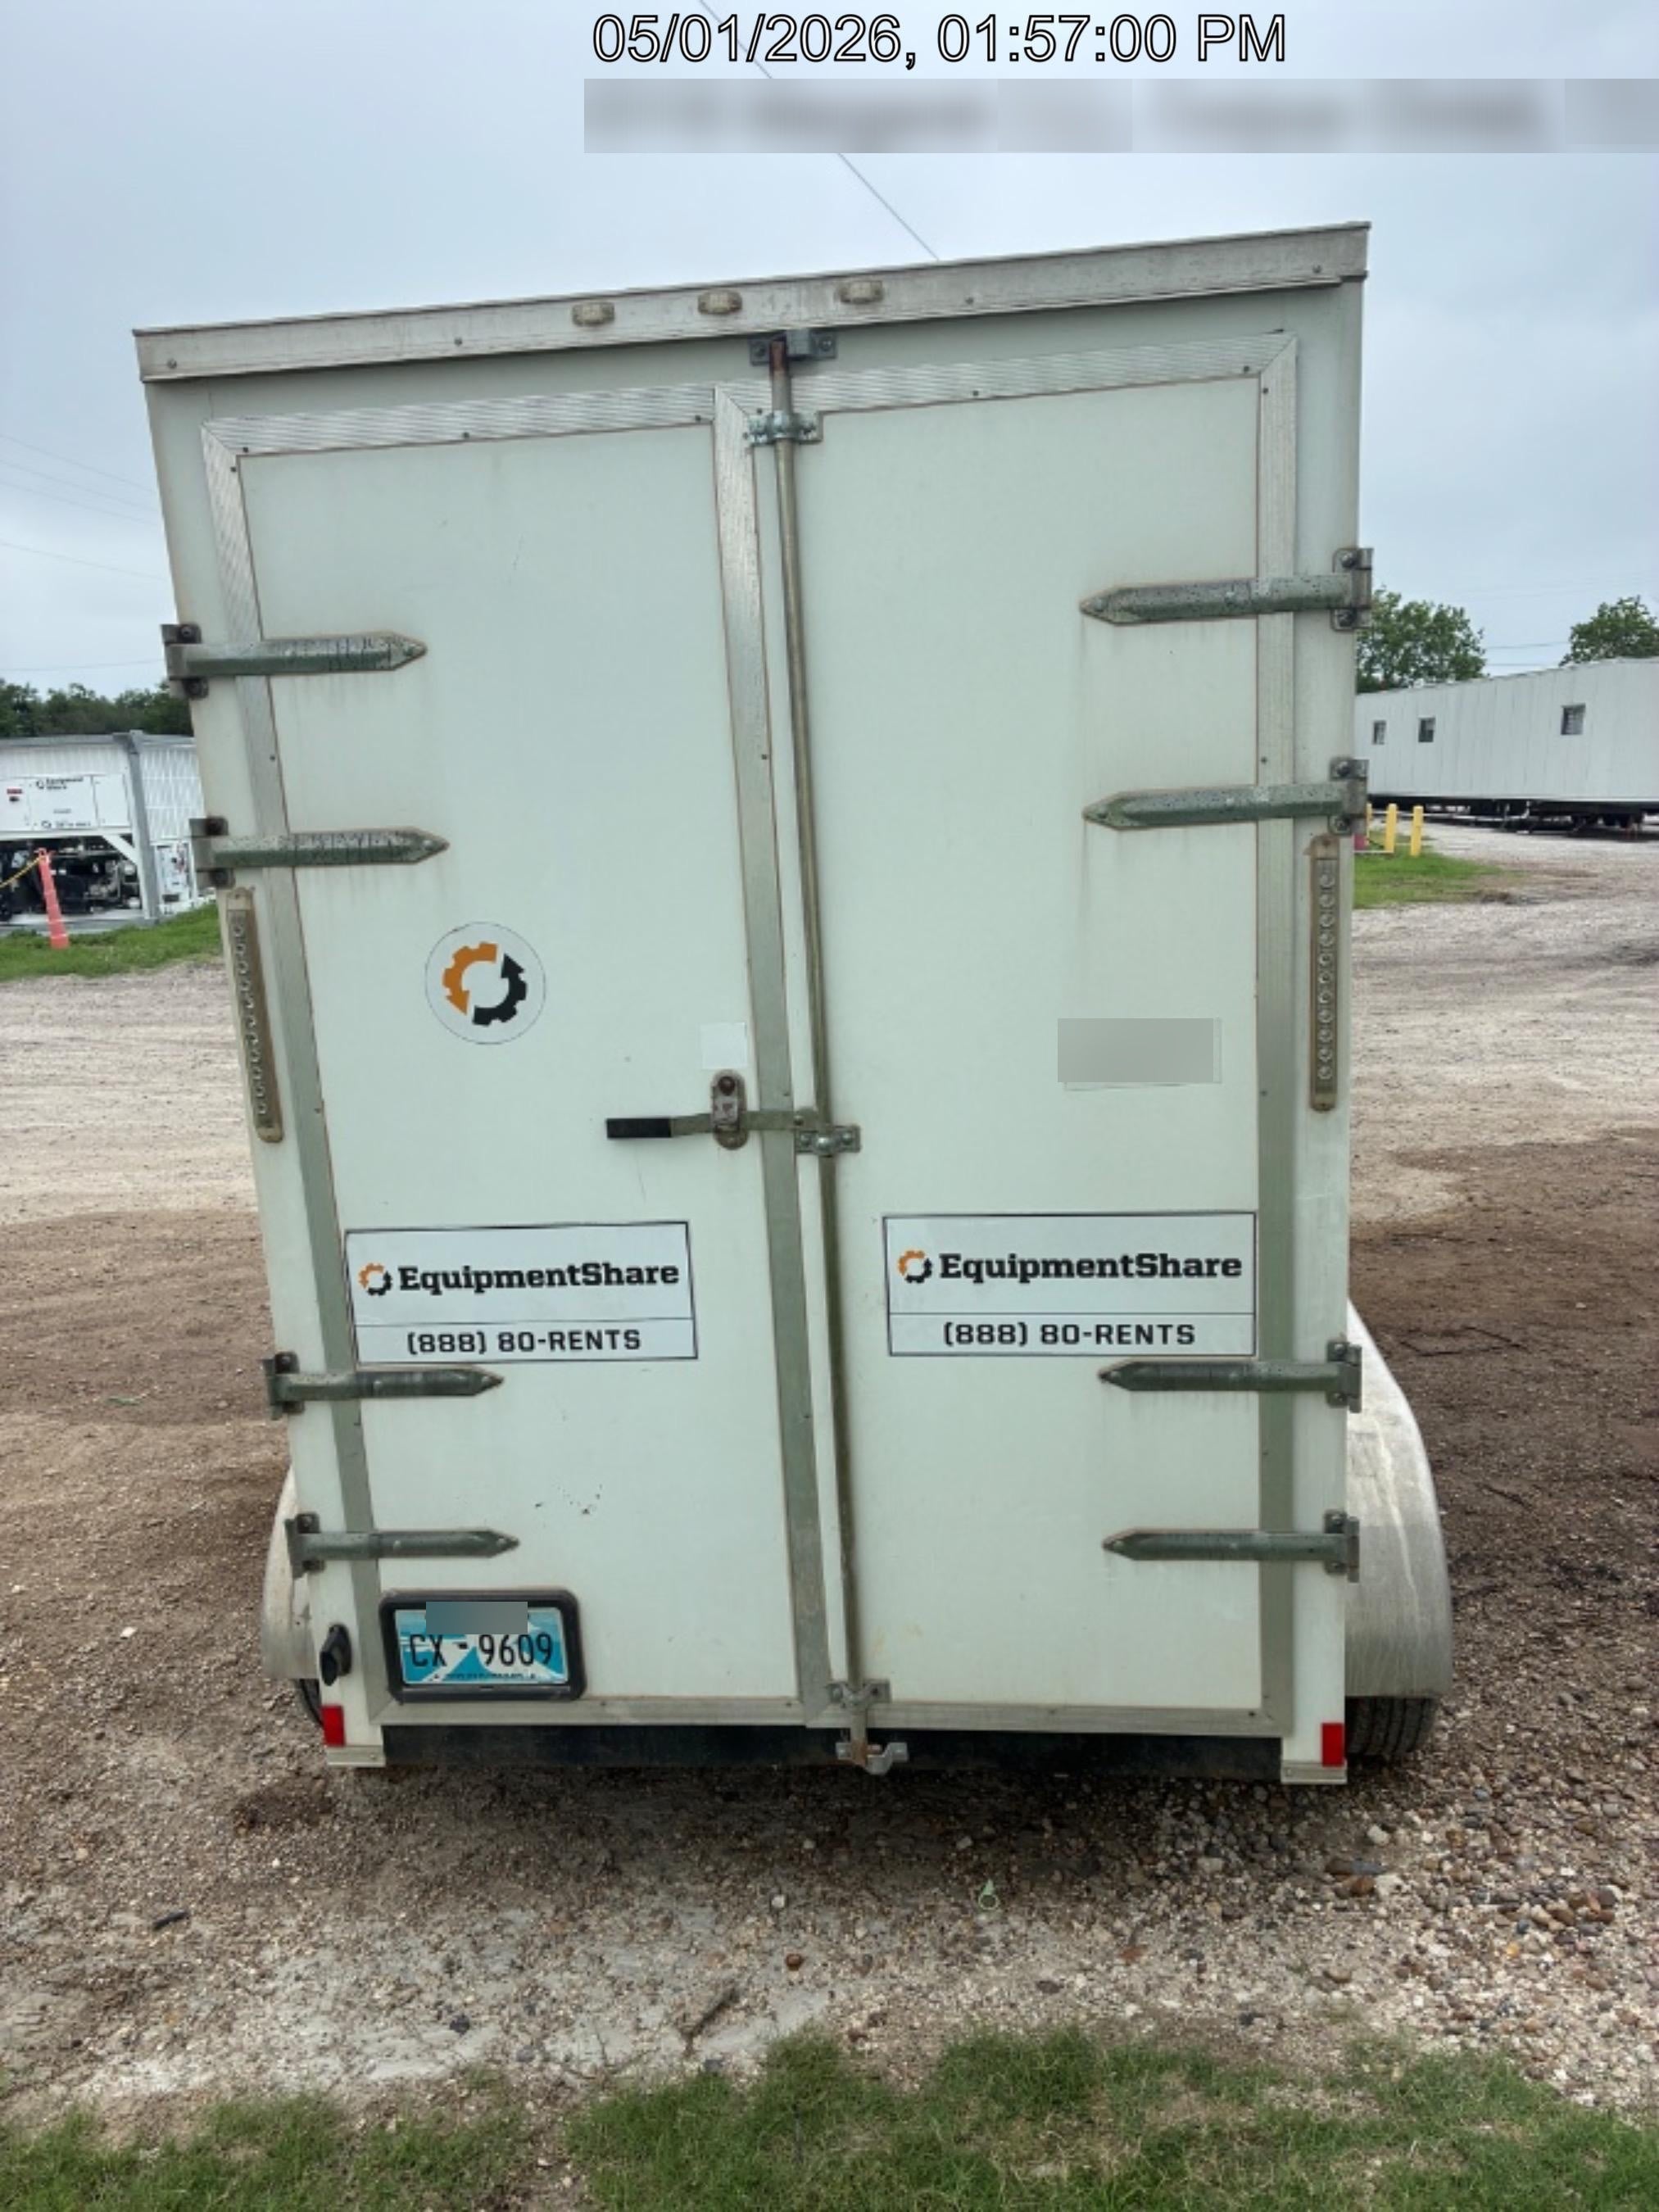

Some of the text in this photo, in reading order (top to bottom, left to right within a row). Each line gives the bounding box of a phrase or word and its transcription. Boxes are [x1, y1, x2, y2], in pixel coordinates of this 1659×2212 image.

[397, 1262, 680, 1296] EquipmentShare
[939, 1253, 1243, 1284] EquipmentShare
[406, 1329, 641, 1356] (888) 80-RENTS
[943, 1321, 1196, 1347] (888) 80-RENTS
